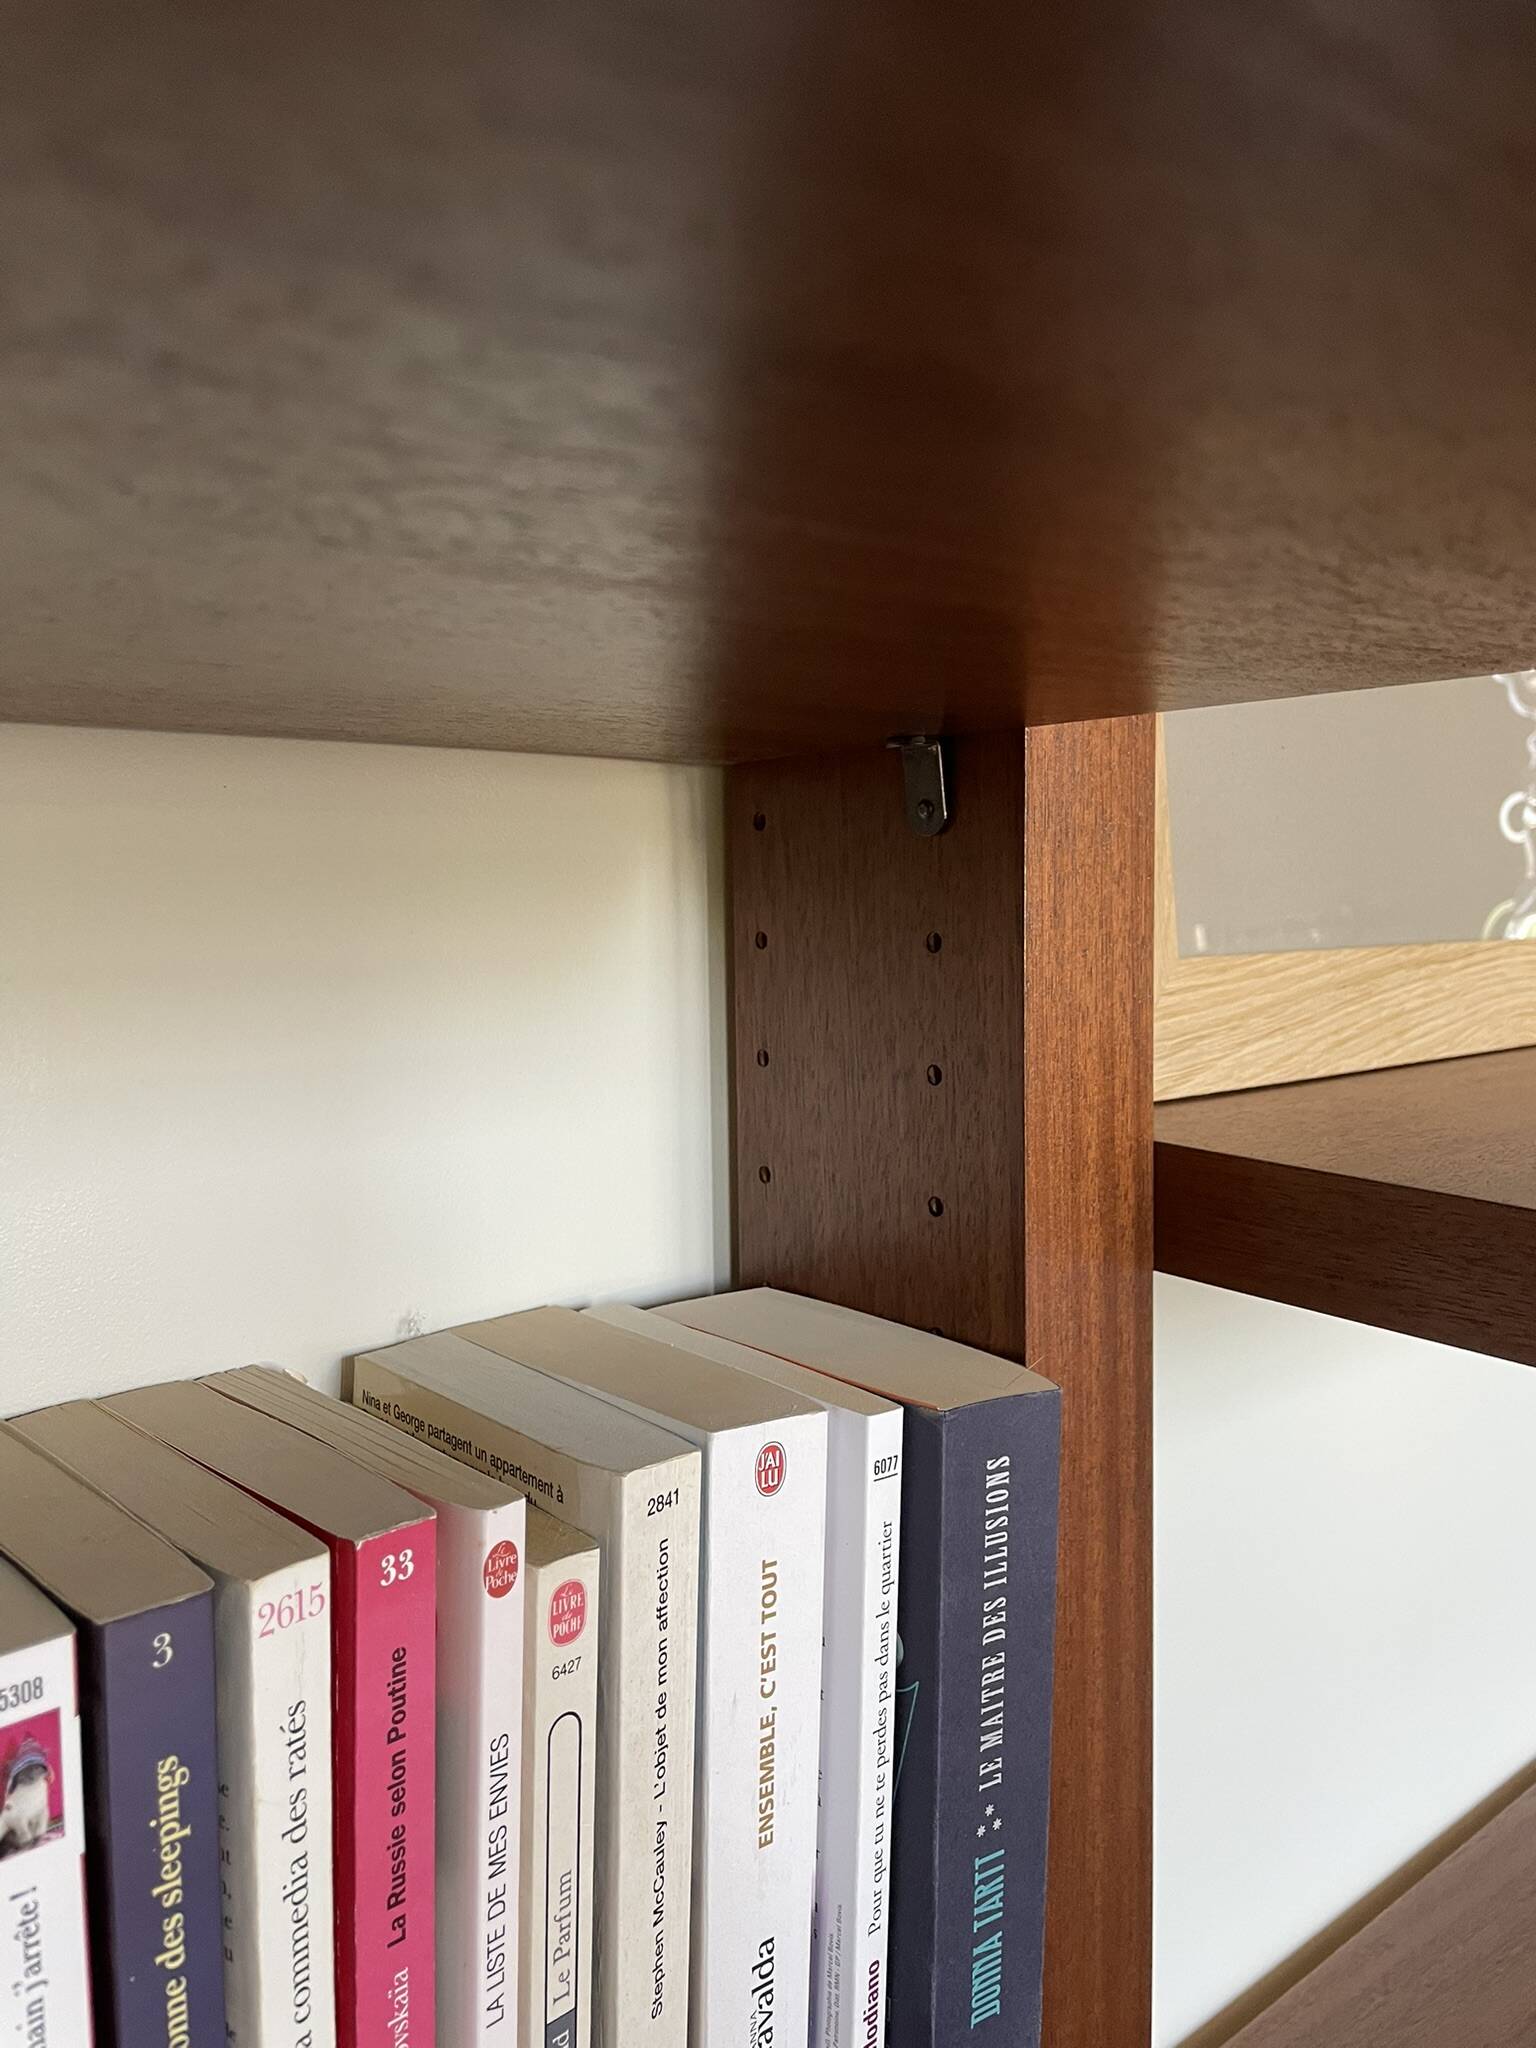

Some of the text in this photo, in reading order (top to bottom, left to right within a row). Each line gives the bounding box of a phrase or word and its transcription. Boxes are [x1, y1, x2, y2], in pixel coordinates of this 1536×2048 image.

[362, 1389, 381, 1411] Nina
[382, 1403, 391, 1416] et
[393, 1404, 425, 1433] George
[428, 1423, 472, 1455] partagent
[474, 1446, 487, 1463] un
[490, 1453, 554, 1498] appartement
[556, 1485, 564, 1504] à
[759, 1450, 780, 1471] J'AI
[761, 1469, 778, 1488] LU
[874, 1455, 898, 1476] 6077
[647, 1488, 679, 1517] 2841
[380, 1549, 415, 1587] 33
[486, 1571, 517, 1591] Poche
[488, 1554, 517, 1572] Livre
[656, 1538, 669, 1631] affection
[258, 1582, 326, 1638] 2615
[553, 1591, 584, 1616] LIVRE
[553, 1615, 582, 1638] POCHE
[978, 1455, 1010, 1792] LE MAITRE DES ILLUSIONS
[152, 1633, 174, 1669] 3
[552, 1656, 581, 1680] 6427
[657, 1637, 668, 1686] mon
[655, 1691, 667, 1719] de
[758, 1559, 778, 1849] ENSEMBLE, C'EST TOUT
[868, 1520, 895, 1938] Pour que tu ne te perdes pas dans le quartier
[279, 1699, 307, 1780] ratés
[653, 1723, 669, 1799] L'objet
[282, 1788, 308, 1843] des
[387, 1646, 408, 1949] La Russie selon Poutine
[150, 1755, 191, 1908] sleepings
[486, 1733, 509, 2029] LA LISTE DE MES ENVIES
[652, 1820, 668, 1928] McCauley
[155, 1912, 186, 1970] des
[283, 1851, 311, 2023] commedia
[552, 1869, 572, 2006] Le Parfum
[971, 1849, 1005, 2029] DONNA TARTT
[651, 1929, 666, 2020] Stephen
[751, 1937, 775, 2048] avalda
